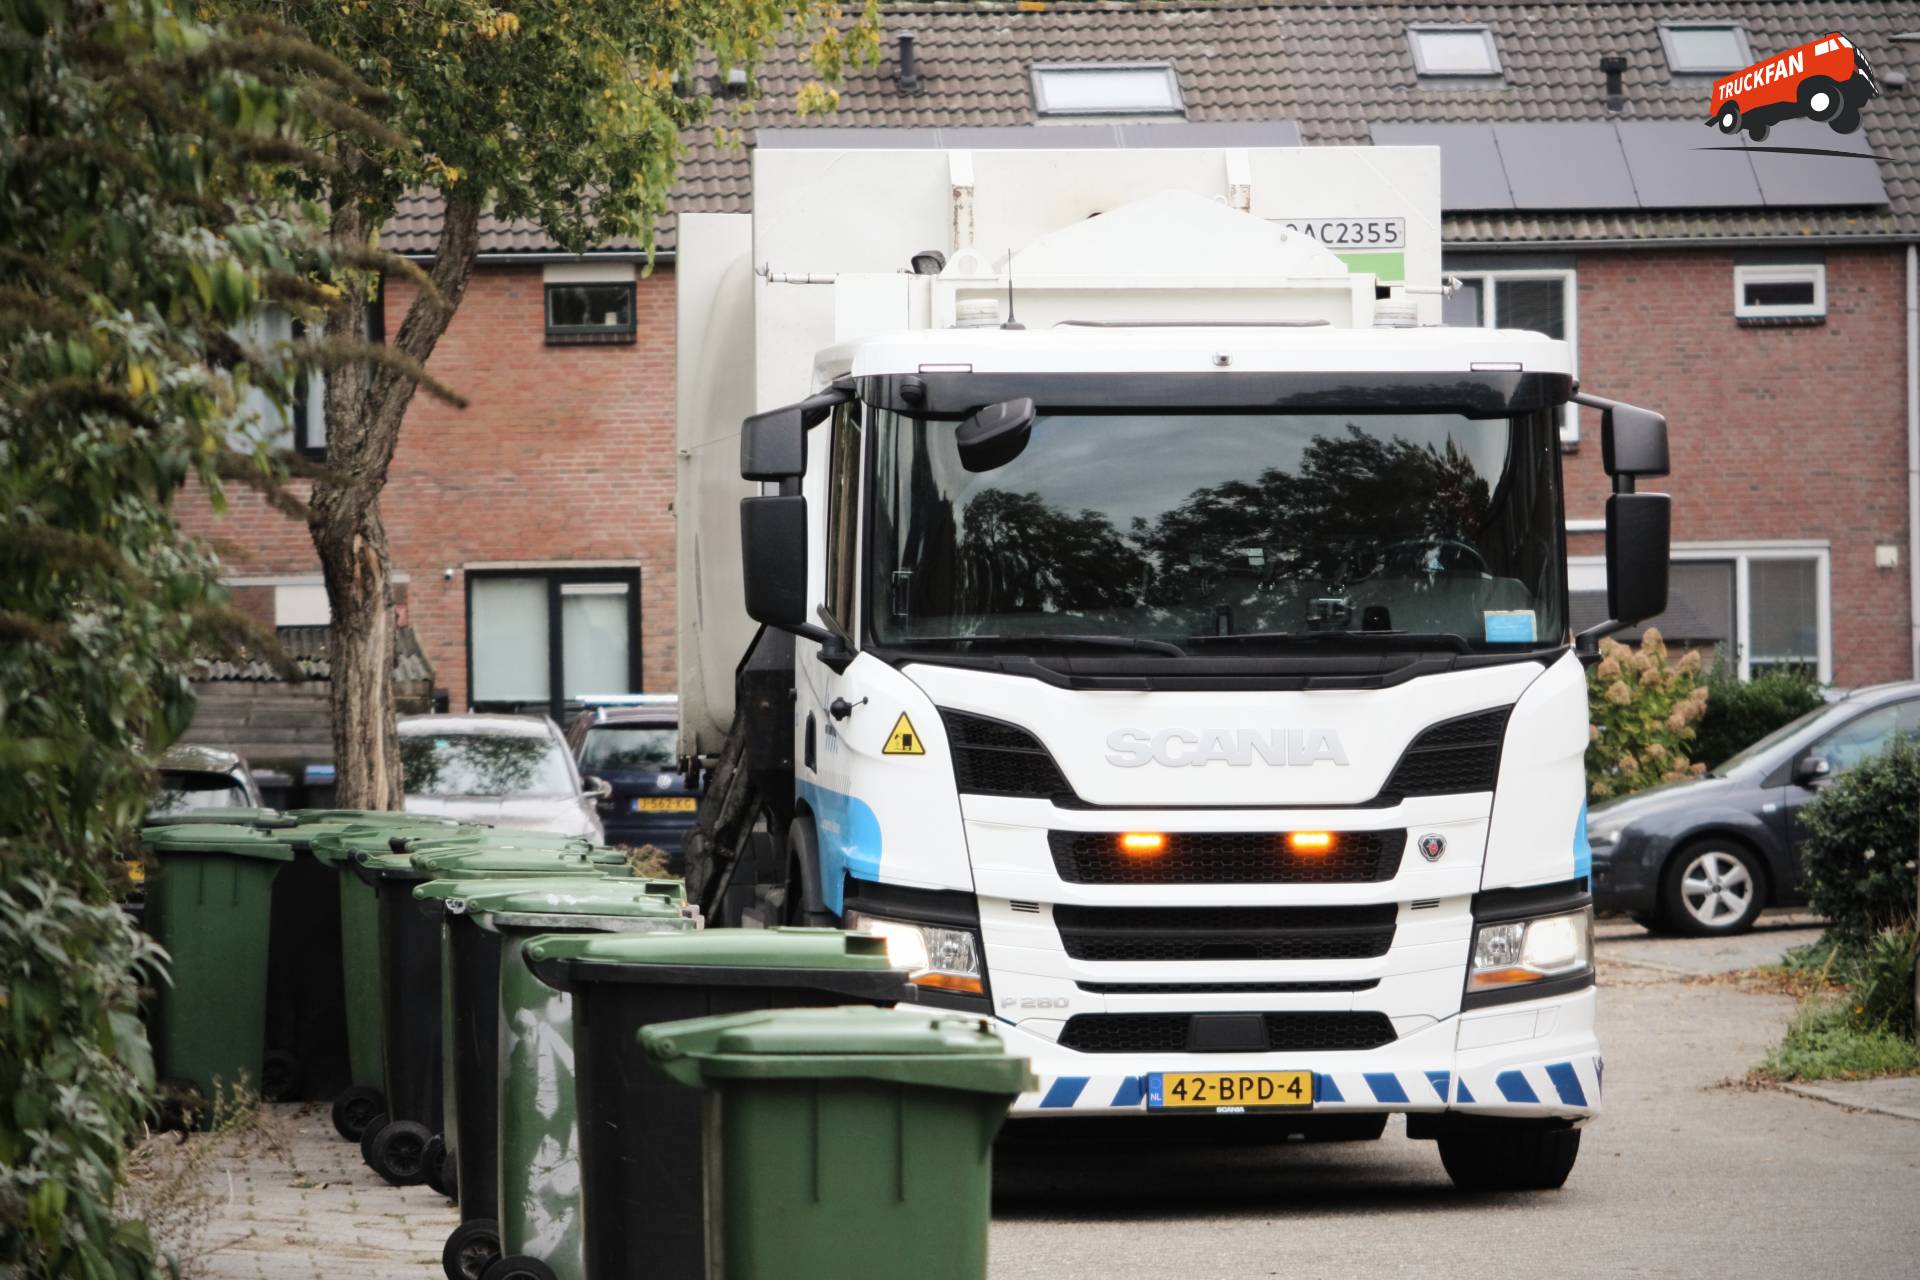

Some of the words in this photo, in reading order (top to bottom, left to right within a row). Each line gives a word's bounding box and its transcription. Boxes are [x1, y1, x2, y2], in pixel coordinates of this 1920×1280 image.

[1105, 728, 1350, 768] SCANIA
[1001, 997, 1016, 1009] P
[1150, 1093, 1162, 1101] NL
[1171, 1076, 1303, 1101] 42-BPD-4
